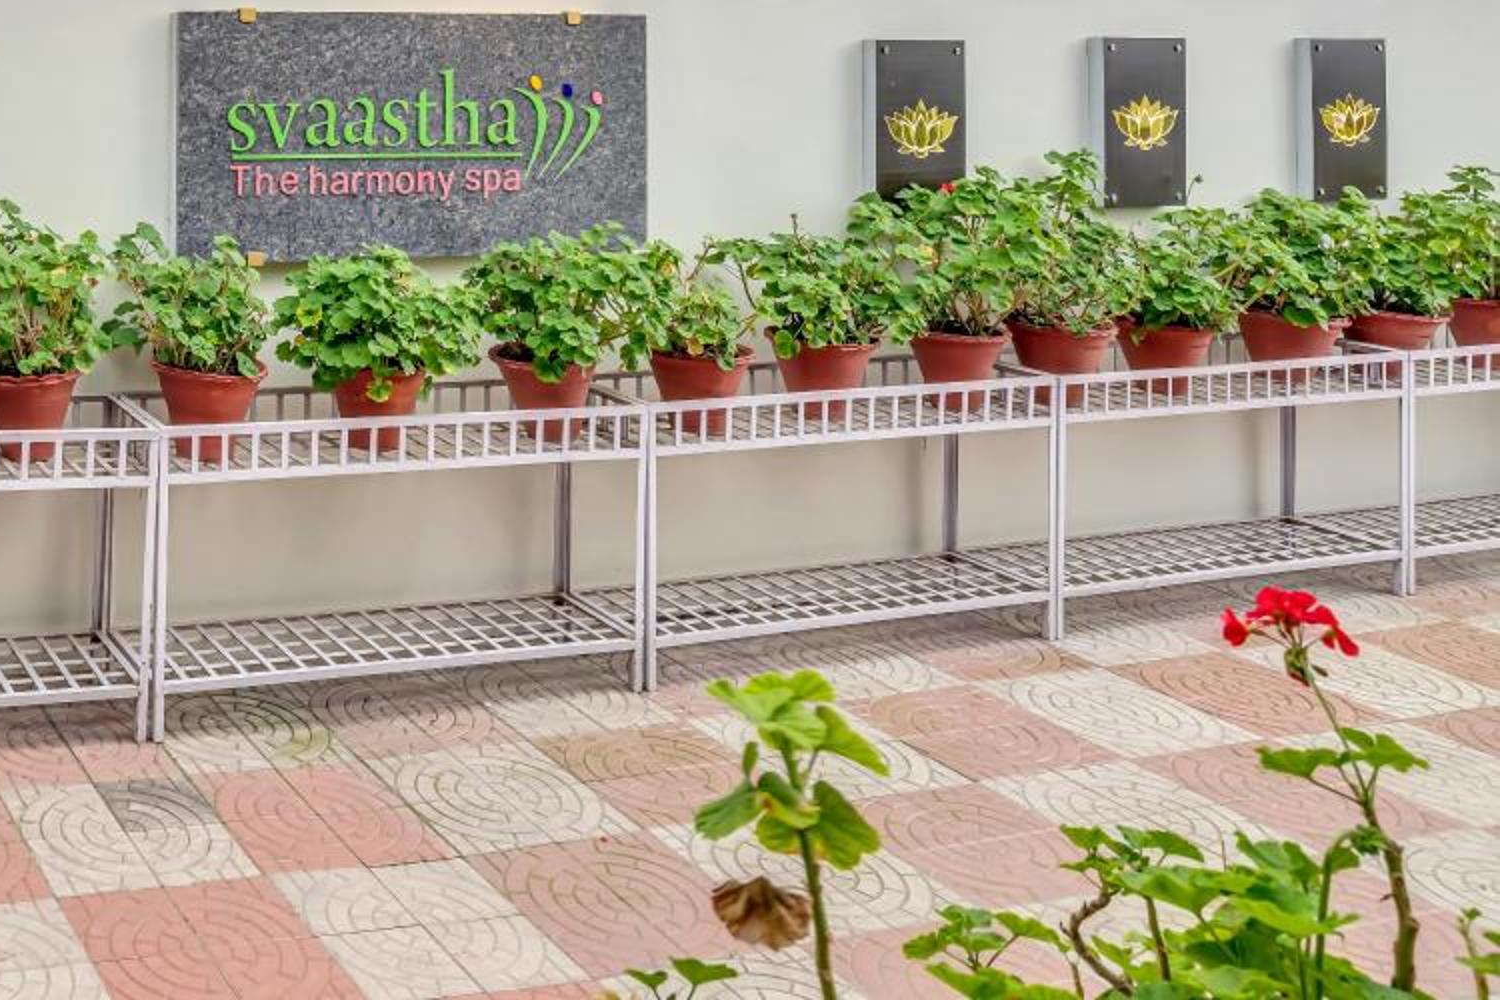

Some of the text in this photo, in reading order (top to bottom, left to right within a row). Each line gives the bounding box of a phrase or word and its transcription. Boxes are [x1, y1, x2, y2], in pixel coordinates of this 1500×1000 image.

[226, 67, 520, 152] svaastha
[230, 164, 522, 200] The harmony spa
